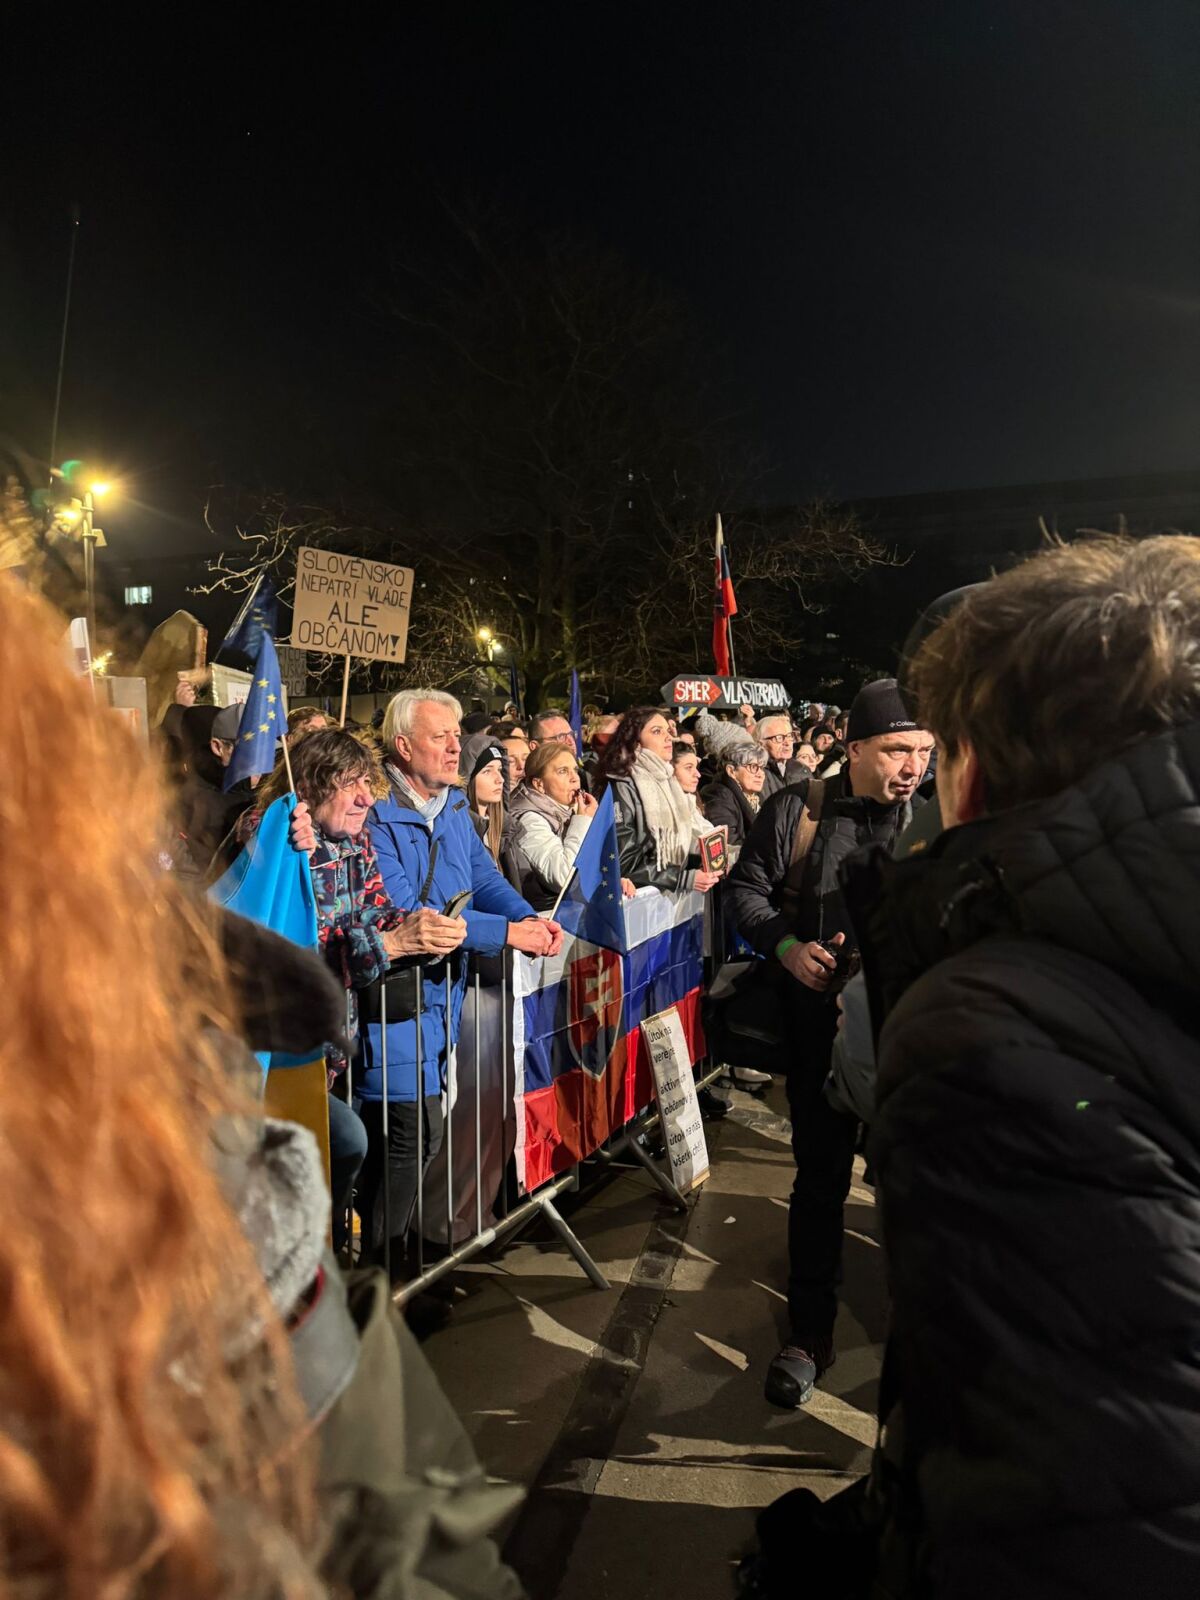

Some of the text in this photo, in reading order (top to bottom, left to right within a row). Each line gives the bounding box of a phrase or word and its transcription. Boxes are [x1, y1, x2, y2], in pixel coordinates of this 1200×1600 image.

[303, 550, 405, 587] SLOVENSKO
[301, 572, 359, 599] NEPATRÍ
[328, 600, 379, 628] ALE
[298, 620, 401, 656] OBČANOM!
[675, 680, 711, 702] SMER
